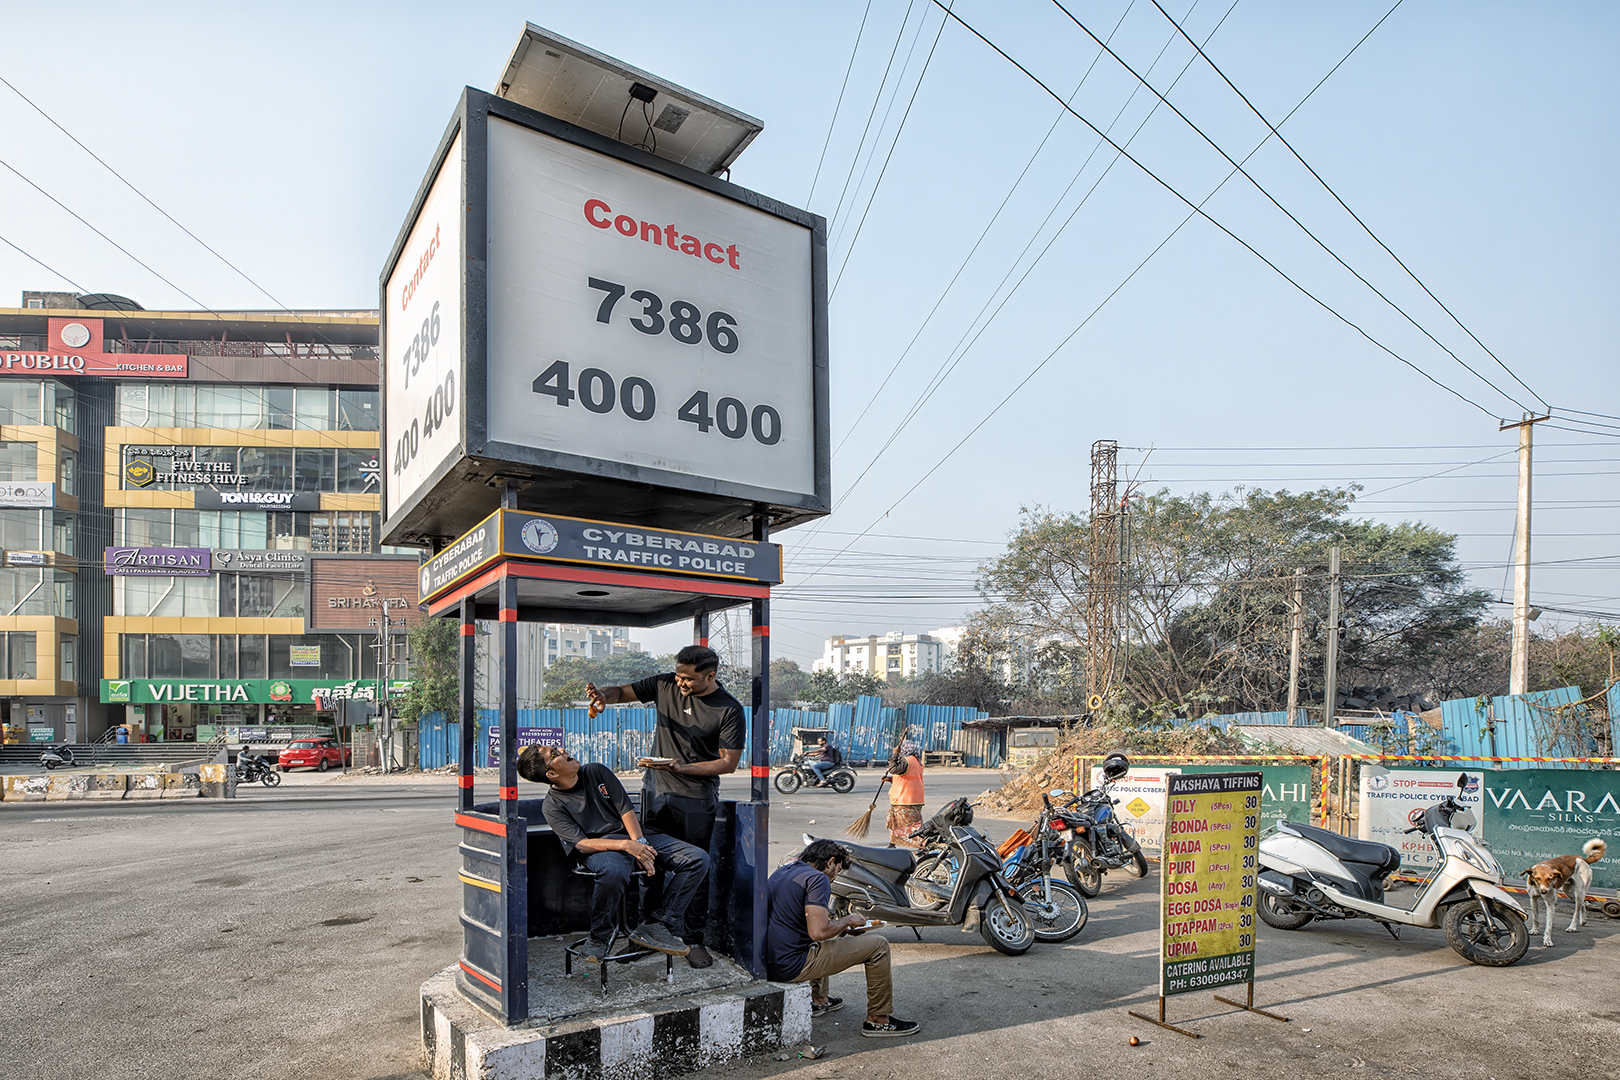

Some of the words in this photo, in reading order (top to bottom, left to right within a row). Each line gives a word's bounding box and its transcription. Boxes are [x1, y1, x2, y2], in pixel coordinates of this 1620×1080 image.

[583, 198, 740, 270] Contact
[402, 222, 441, 312] Contact
[587, 276, 739, 355] 7386
[402, 300, 441, 391] 7386
[6, 354, 85, 374] PUBLIQ
[116, 364, 155, 372] KITCHEN
[531, 359, 657, 422] 400
[677, 389, 782, 446] 400
[393, 417, 419, 477] 400
[422, 369, 455, 440] 400
[172, 462, 201, 472] FIVE
[204, 462, 231, 472] THE
[156, 472, 211, 483] FITNESS
[214, 474, 246, 484] HIVE
[220, 492, 295, 504] TONI&GUY
[433, 528, 486, 572] CYBERABAD
[582, 528, 755, 559] CYBERABAD
[236, 551, 262, 563] Asya
[265, 552, 303, 562] Clinics
[583, 545, 673, 566] TRAFFIC
[679, 556, 746, 574] POLICE
[433, 562, 458, 588] TRAFFIC
[458, 547, 483, 574] POLICE
[328, 597, 350, 608] SRI
[353, 597, 408, 608] HARHA
[148, 684, 249, 701] VIJETHA
[519, 738, 561, 746] THEATERS
[1173, 778, 1220, 791] AKSHAYA
[1222, 776, 1259, 789] TIFFINS
[1393, 779, 1417, 787] STOP
[1171, 799, 1197, 814] IDLY
[1211, 802, 1232, 811] (5Pcs)
[1245, 795, 1257, 809] 30
[1170, 819, 1208, 834] BONDA
[1210, 822, 1231, 832] (5Pcs)
[1244, 815, 1256, 829] 30
[1548, 813, 1594, 823] SILKS
[1169, 840, 1201, 855] WADA
[1209, 843, 1231, 853] (5Pcs)
[1243, 835, 1255, 849] 30
[1402, 842, 1433, 852] KPHB
[1168, 860, 1195, 875] PURI
[1208, 863, 1230, 873] (3Pcs)
[1242, 855, 1254, 868] 30
[1168, 880, 1198, 896] DOSA
[1208, 881, 1226, 891] (Any)
[1241, 875, 1253, 888] 30
[1168, 901, 1191, 916] EGG
[1193, 898, 1222, 914] DOSA
[1240, 894, 1253, 908] 40
[1168, 918, 1217, 937] UTAPPAM
[1240, 914, 1252, 928] 30
[1167, 941, 1198, 958] UPMA
[1239, 933, 1251, 947] 30
[1167, 960, 1207, 978] CATERING
[1209, 954, 1251, 971] AVAILABLE
[1170, 980, 1187, 990] PH:
[1189, 968, 1249, 987] 6300904347
